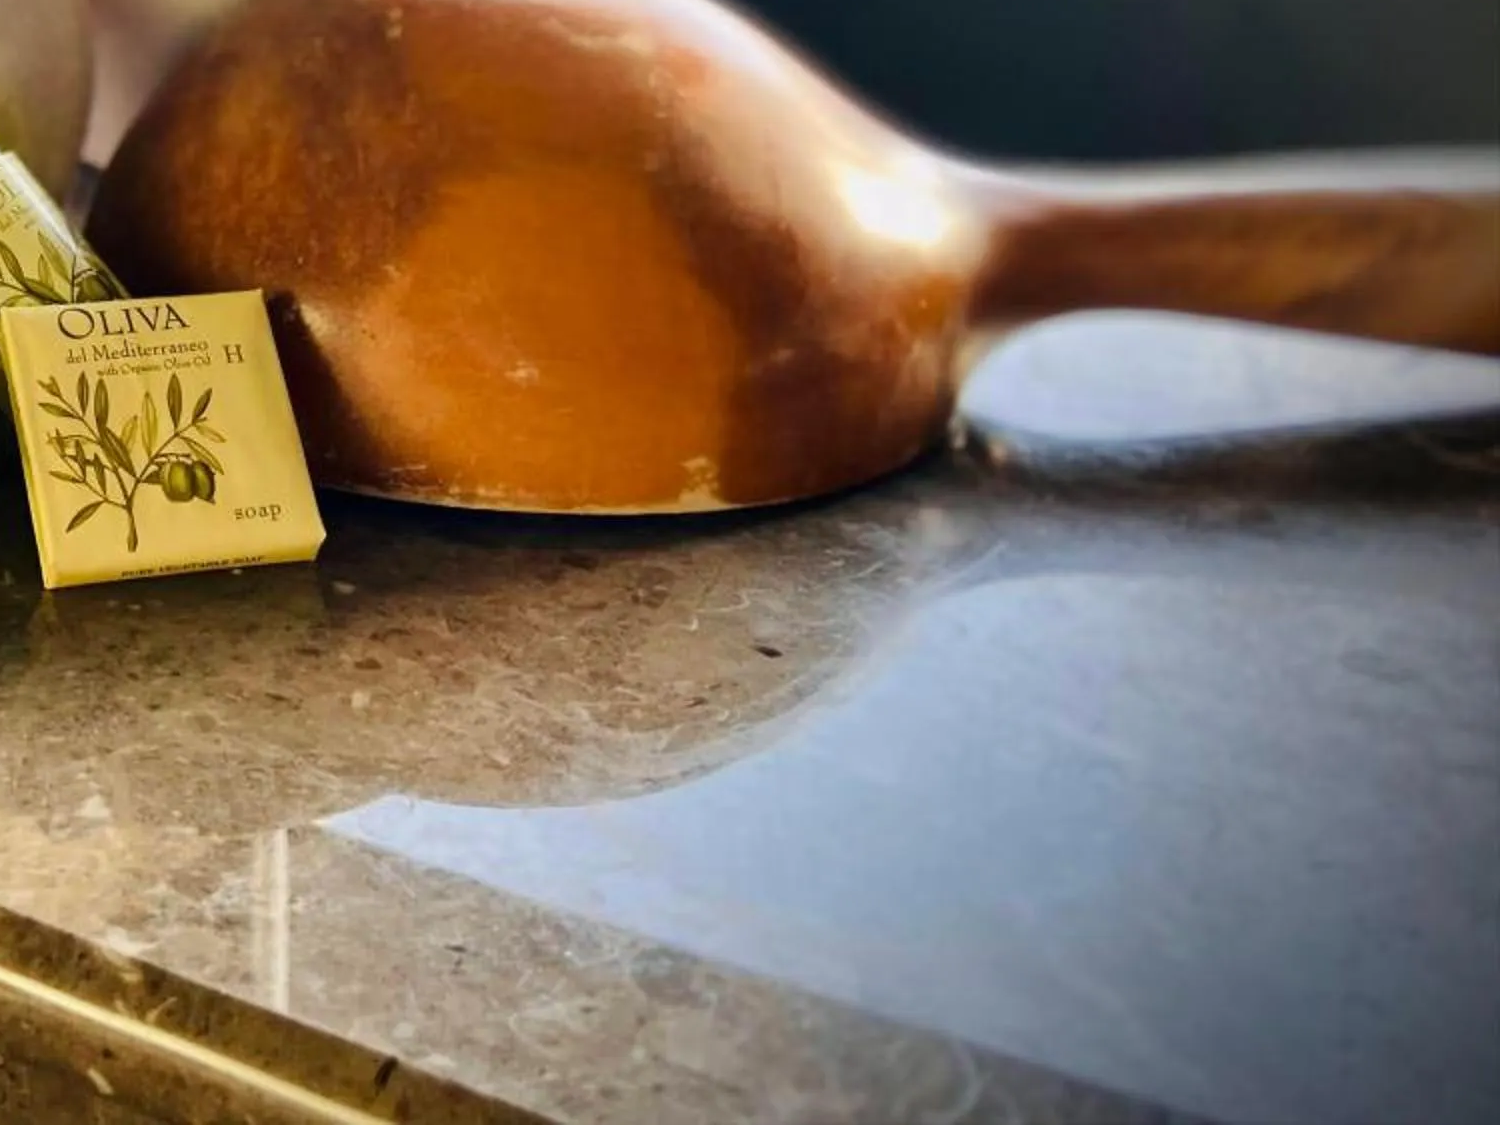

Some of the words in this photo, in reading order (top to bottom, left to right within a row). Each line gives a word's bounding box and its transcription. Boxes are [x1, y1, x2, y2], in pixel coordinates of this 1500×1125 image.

[57, 302, 191, 340] OLIVA
[65, 347, 88, 365] del
[91, 338, 209, 362] Mediterraneo
[222, 343, 245, 365] H
[234, 503, 282, 521] soap
